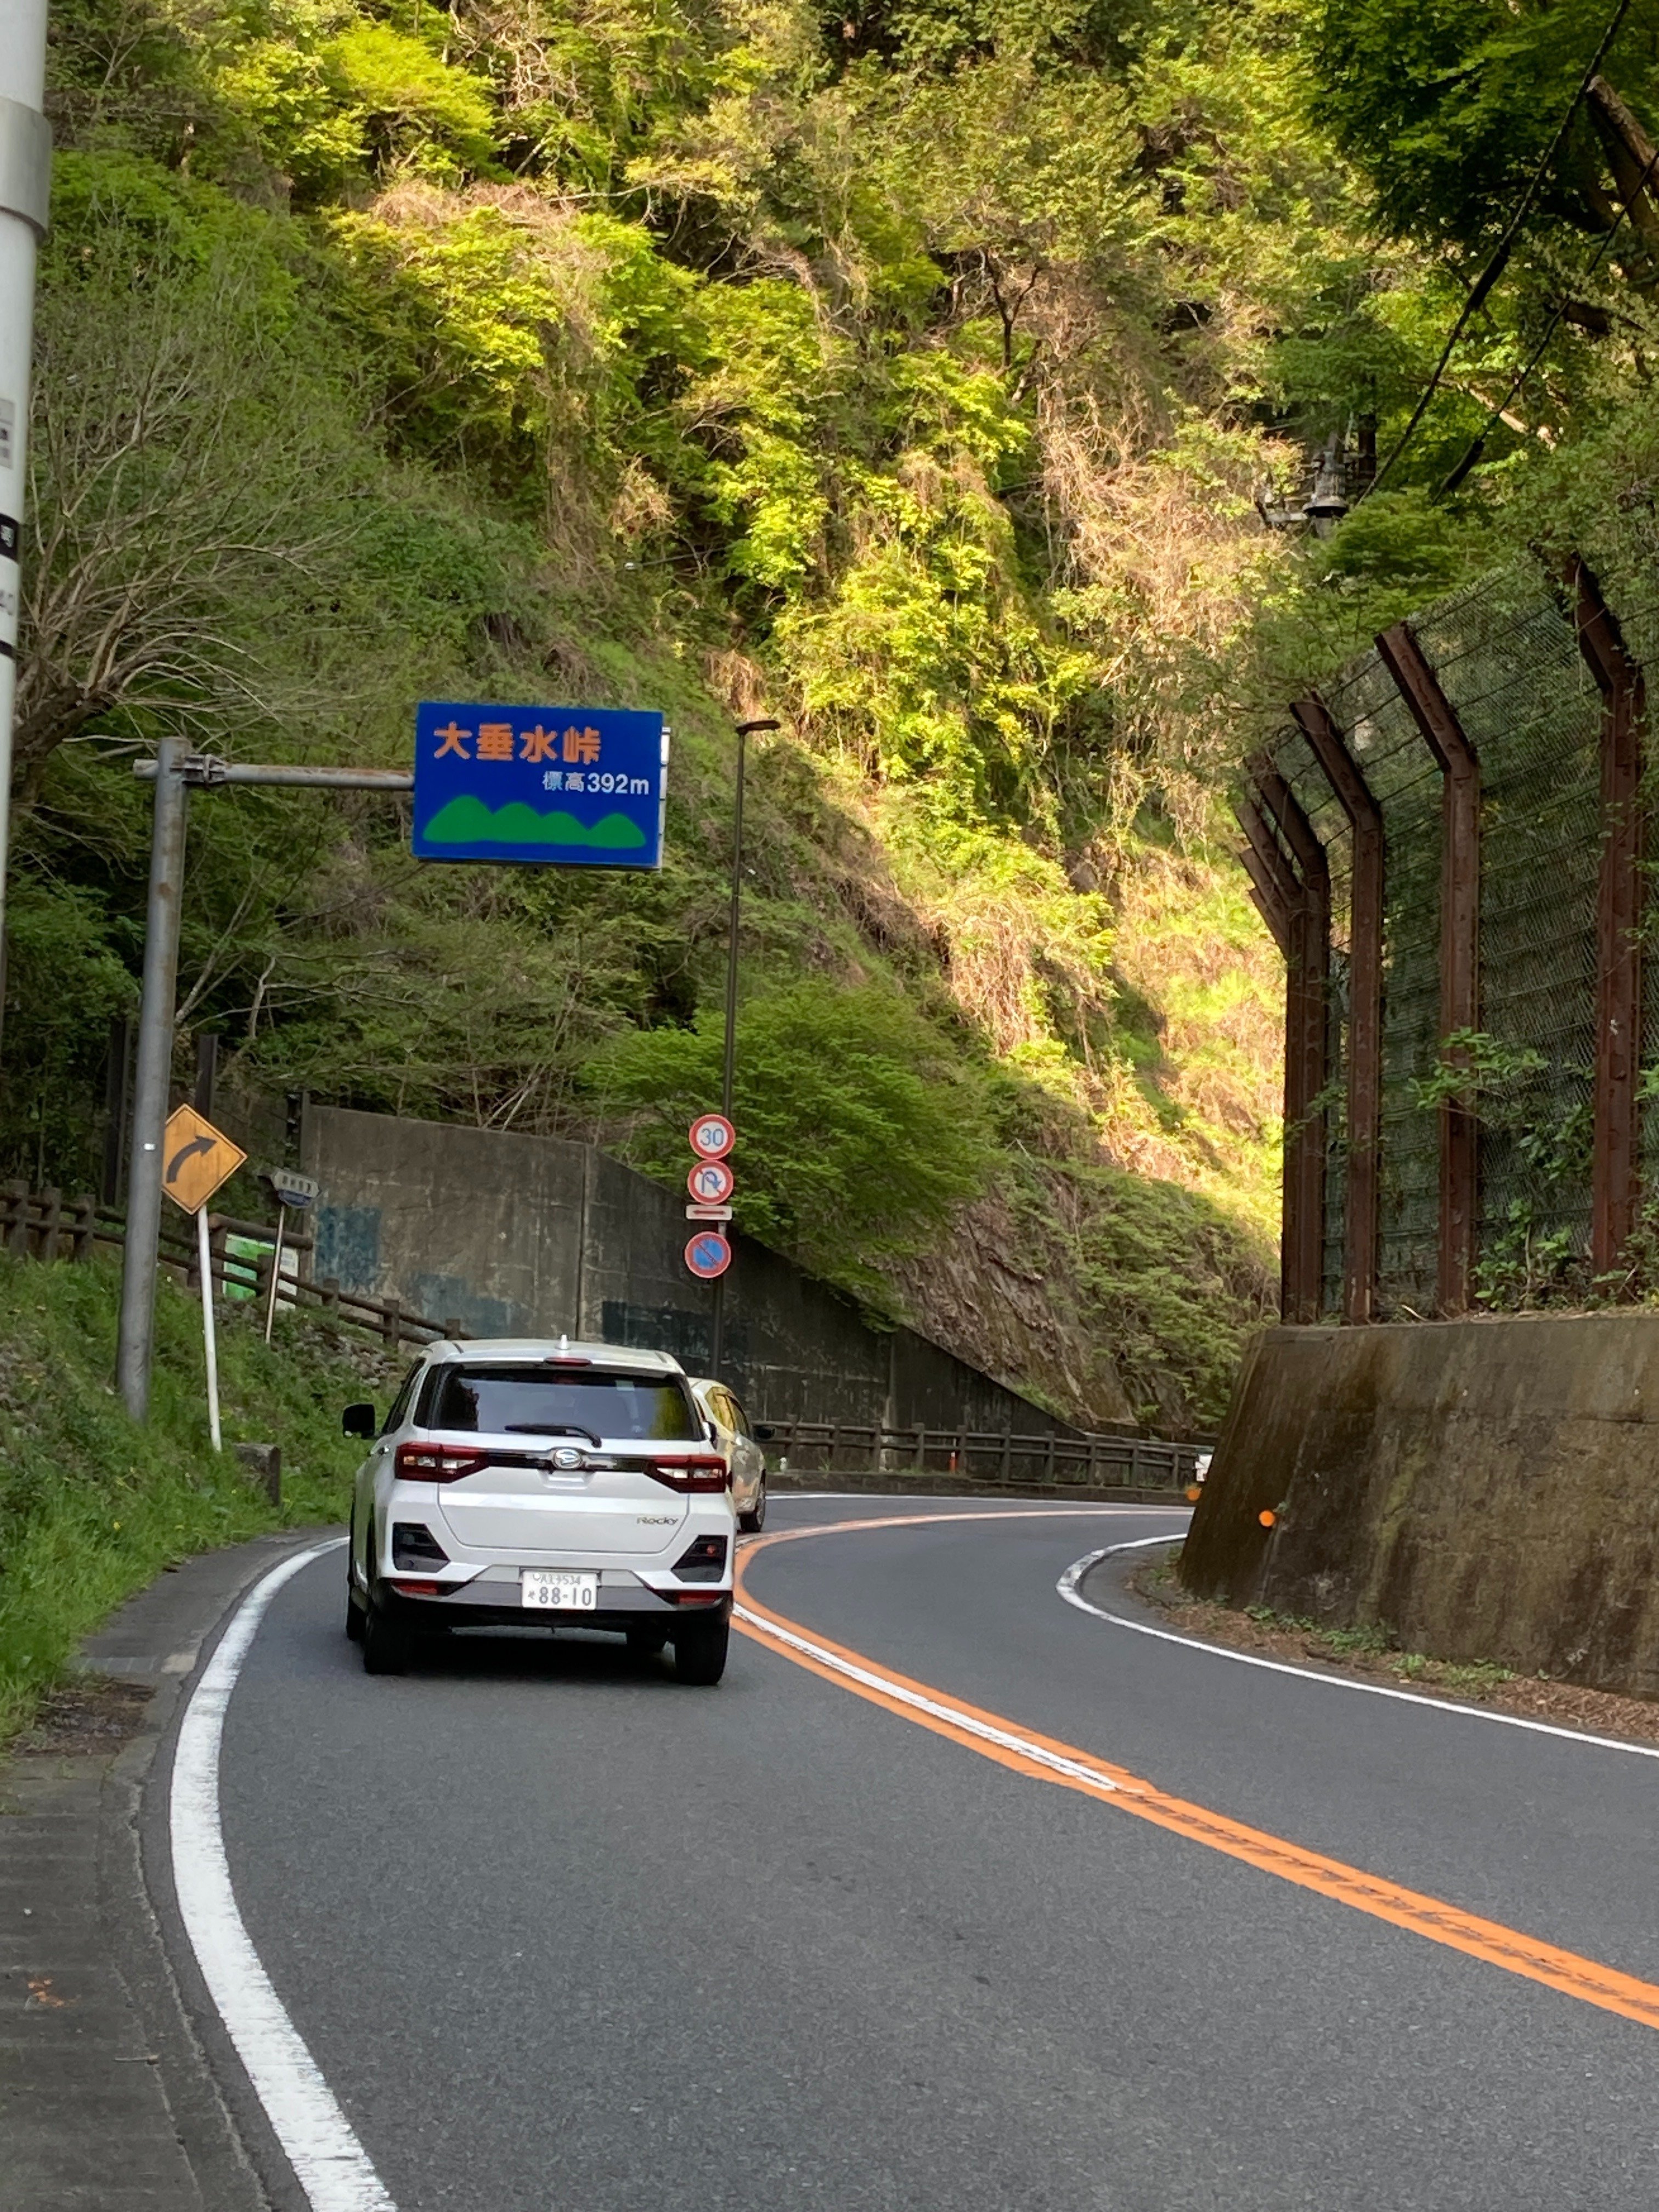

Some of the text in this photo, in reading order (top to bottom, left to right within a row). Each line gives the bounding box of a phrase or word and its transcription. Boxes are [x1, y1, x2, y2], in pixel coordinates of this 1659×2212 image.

[433, 721, 601, 765] 大垂水峠
[700, 1128, 724, 1147] 30
[636, 1517, 678, 1525] Rocky
[539, 1586, 592, 1606] 88-10
